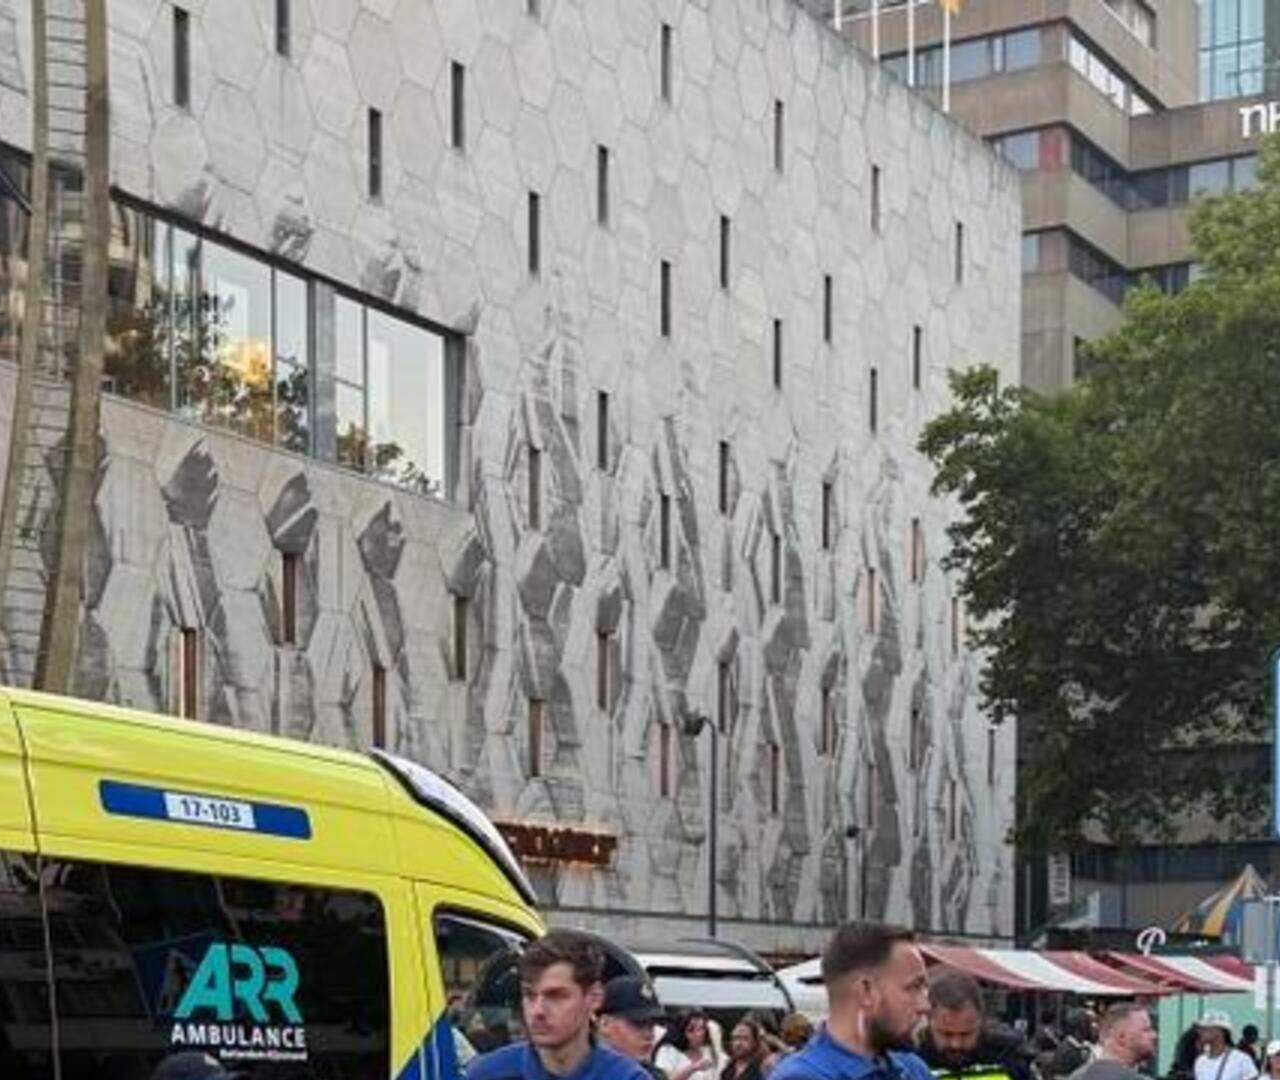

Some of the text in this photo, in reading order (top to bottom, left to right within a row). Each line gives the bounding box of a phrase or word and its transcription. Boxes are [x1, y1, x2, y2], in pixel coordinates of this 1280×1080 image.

[180, 798, 242, 824] 17-103
[173, 943, 304, 1024] ARR
[171, 1022, 307, 1049] AMBULANCE
